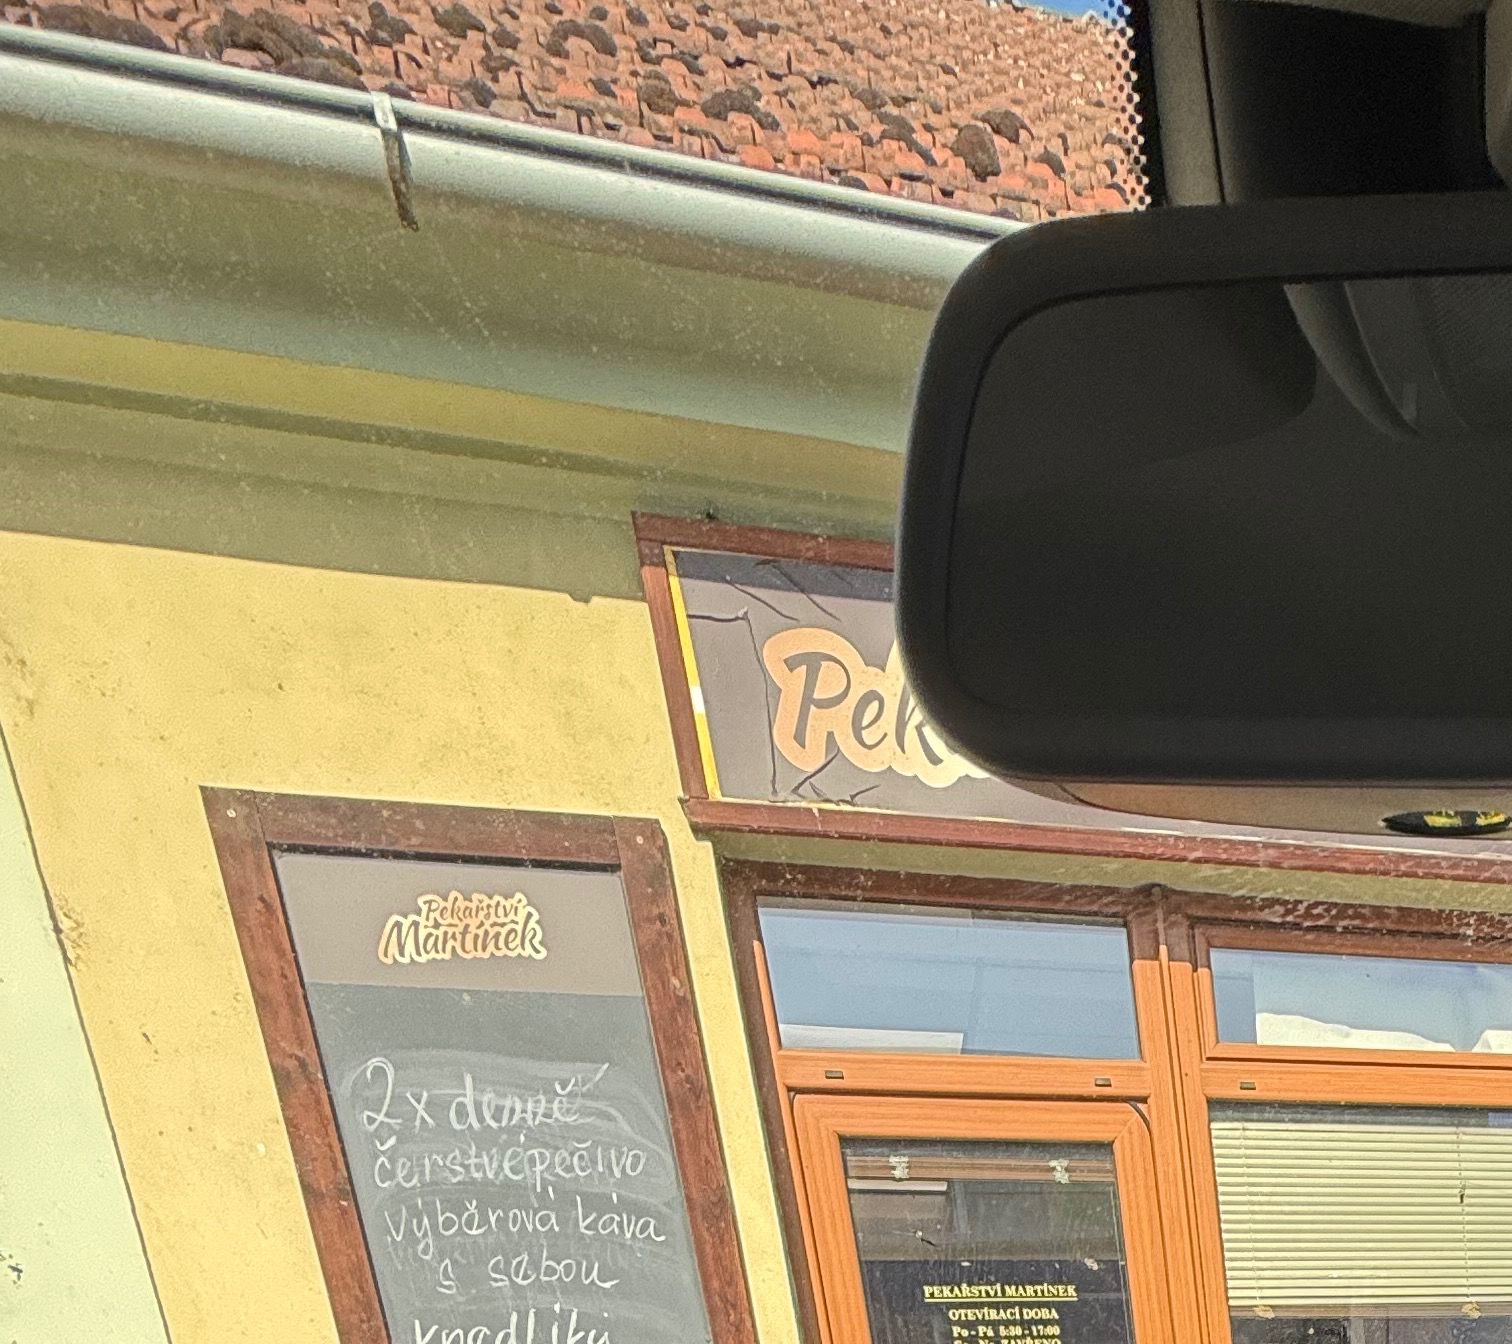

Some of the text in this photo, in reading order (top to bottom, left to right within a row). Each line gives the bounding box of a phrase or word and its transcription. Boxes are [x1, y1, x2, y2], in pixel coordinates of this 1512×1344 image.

[423, 896, 522, 922] Pekařství
[383, 911, 541, 958] Martínek
[923, 1283, 1078, 1298] PEKAŘSTVÍ MARTÍNEK
[949, 1306, 1059, 1321] OTEVÍRACÍ DOBA
[952, 1325, 969, 1338] Po
